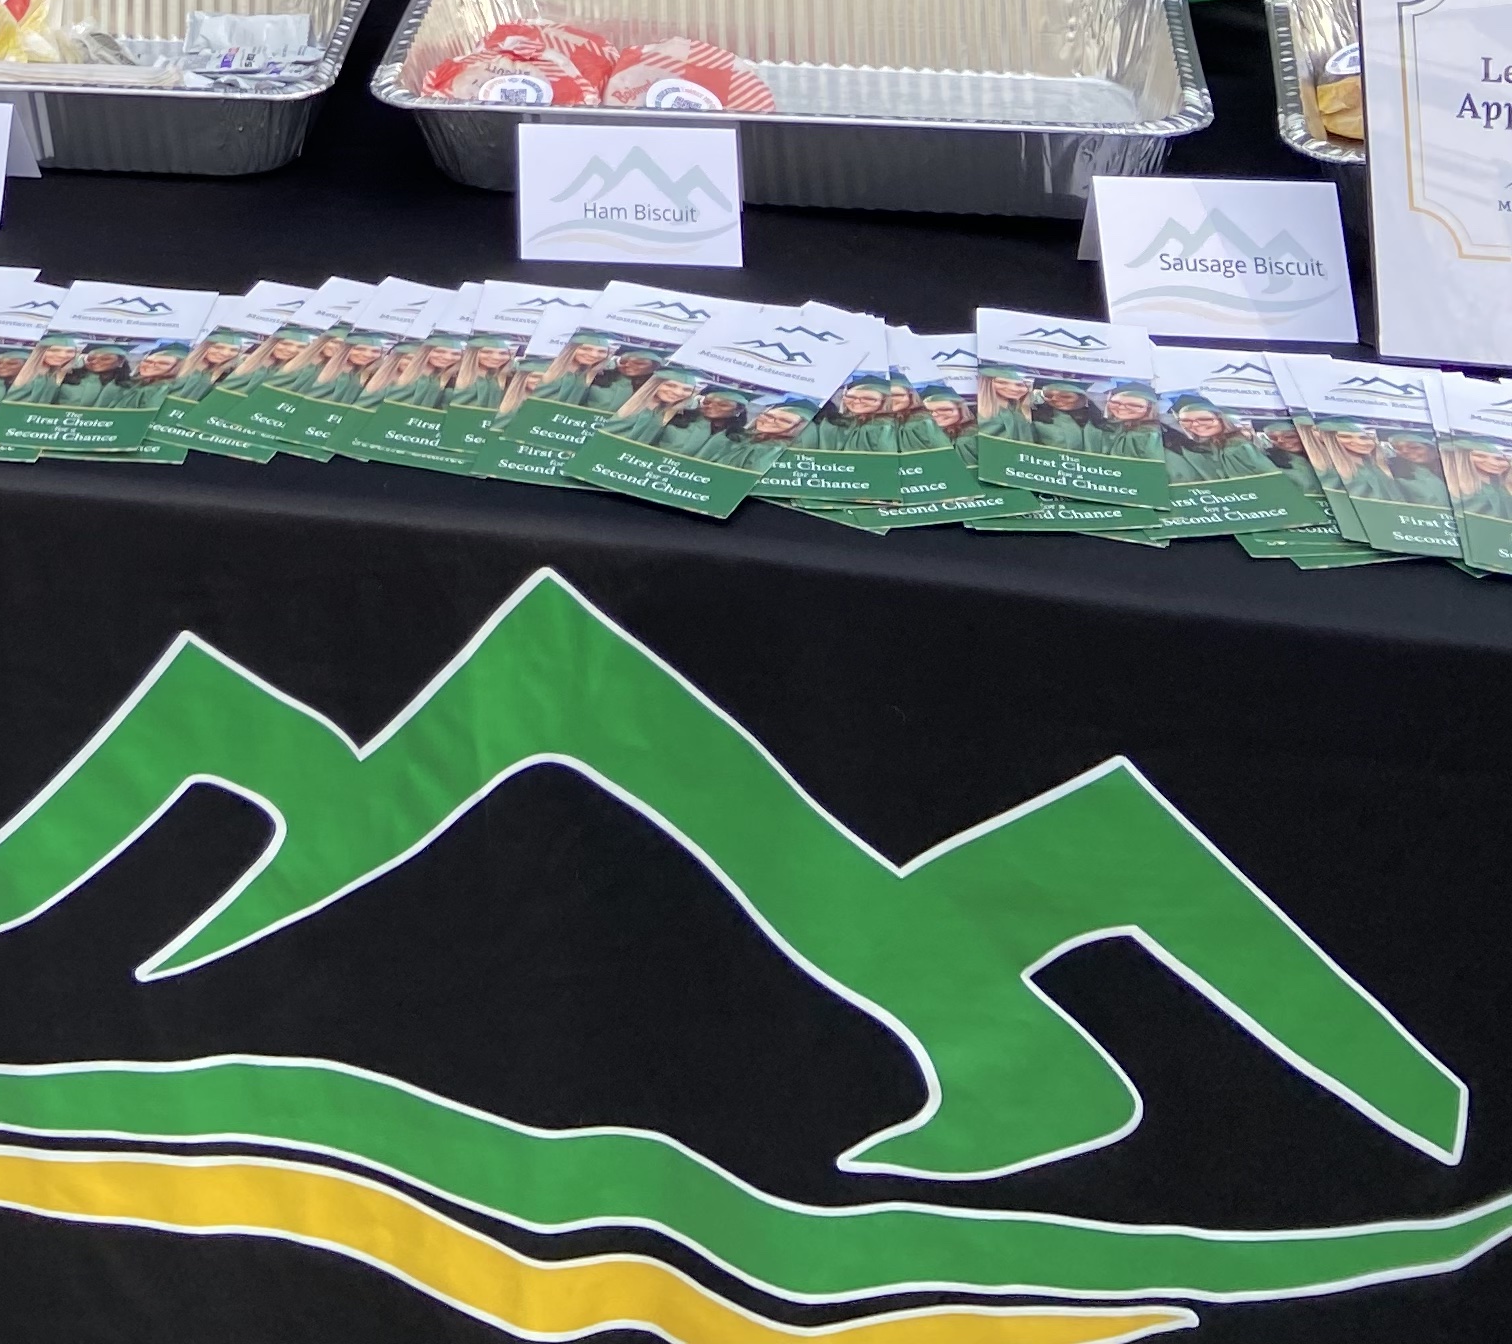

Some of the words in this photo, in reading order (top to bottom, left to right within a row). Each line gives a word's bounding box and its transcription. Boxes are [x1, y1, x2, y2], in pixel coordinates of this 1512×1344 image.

[584, 202, 628, 220] Ham
[634, 204, 698, 222] Biscuit
[1159, 253, 1247, 278] Sausage
[1254, 257, 1326, 277] Biscuit
[26, 414, 59, 426] First
[62, 418, 115, 427] Choice
[552, 413, 588, 428] First
[5, 428, 58, 441] Second
[61, 431, 118, 442] Chance
[305, 426, 331, 439] Sec
[385, 430, 440, 447] Second
[529, 425, 587, 445] Second
[517, 444, 553, 459] First
[796, 454, 815, 462] The
[1059, 454, 1080, 462] The
[497, 459, 555, 476] Second
[616, 452, 654, 469] First
[656, 464, 711, 484] Choice
[662, 456, 681, 467] The
[796, 462, 856, 473] Choice
[1018, 453, 1057, 468] First
[1061, 462, 1122, 478] Choice
[645, 471, 661, 480] for
[792, 470, 808, 479] for
[1057, 469, 1073, 478] for
[591, 463, 649, 487] Second
[651, 481, 710, 502] Chance
[806, 478, 870, 490] Chance
[1005, 467, 1067, 486] Second
[1072, 479, 1138, 496] Chance
[1199, 492, 1258, 505] Choice
[878, 503, 939, 517] Second
[941, 497, 1005, 511] Chance
[1225, 507, 1288, 521] Chance
[1058, 510, 1123, 520] Chance
[1398, 515, 1440, 528] First
[1392, 531, 1459, 547] Second
